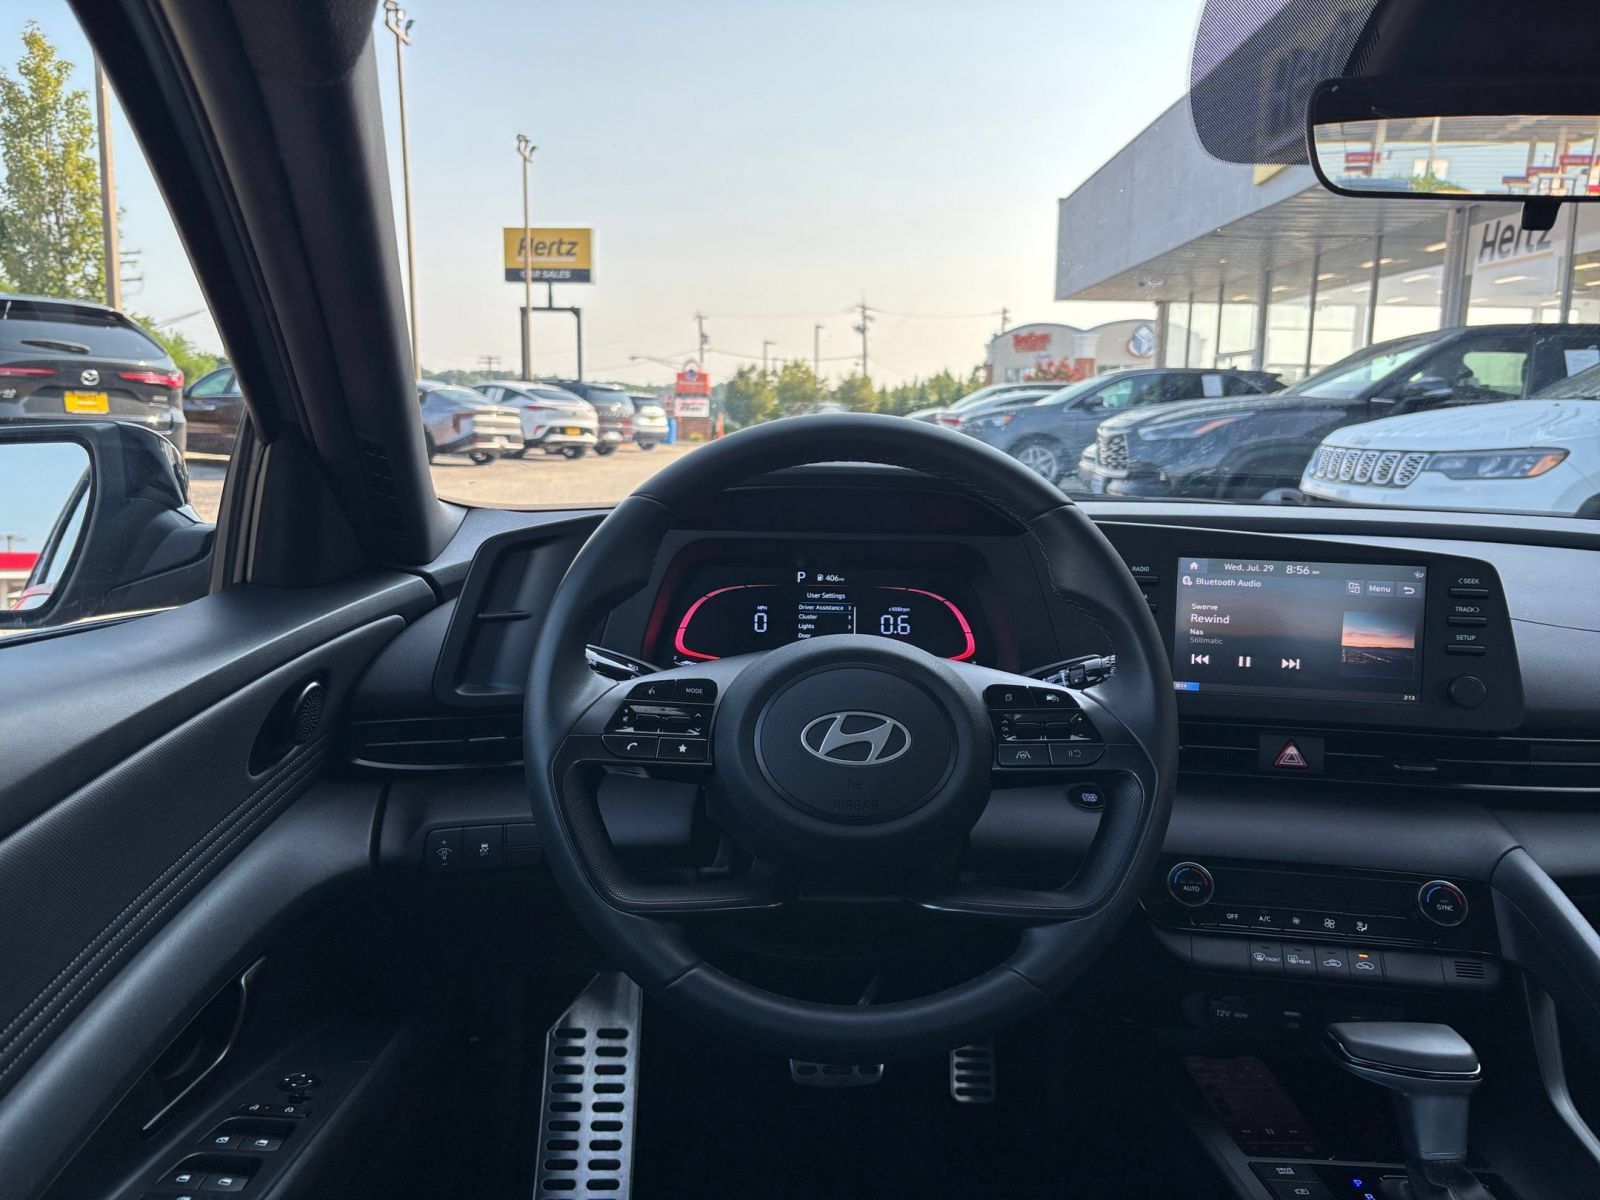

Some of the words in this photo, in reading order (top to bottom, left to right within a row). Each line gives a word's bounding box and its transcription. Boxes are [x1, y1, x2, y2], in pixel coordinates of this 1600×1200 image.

[517, 238, 579, 256] Hertz
[541, 271, 571, 279] SALES
[1263, 564, 1274, 572] 29
[1286, 565, 1310, 575] 8:56
[797, 571, 806, 583] P
[1196, 577, 1236, 586] Bluetooth
[1237, 579, 1261, 587] Audio
[1369, 584, 1391, 593] Menu
[821, 592, 846, 600] Settings
[754, 612, 768, 633] 0
[1190, 613, 1230, 624] Rewind
[880, 615, 911, 635] 0.6
[1190, 636, 1224, 645] Stillmatic
[1183, 885, 1200, 893] AUTO
[1436, 904, 1455, 912] SYNC
[1226, 912, 1239, 920] OFF
[1216, 1008, 1231, 1017] 12V
